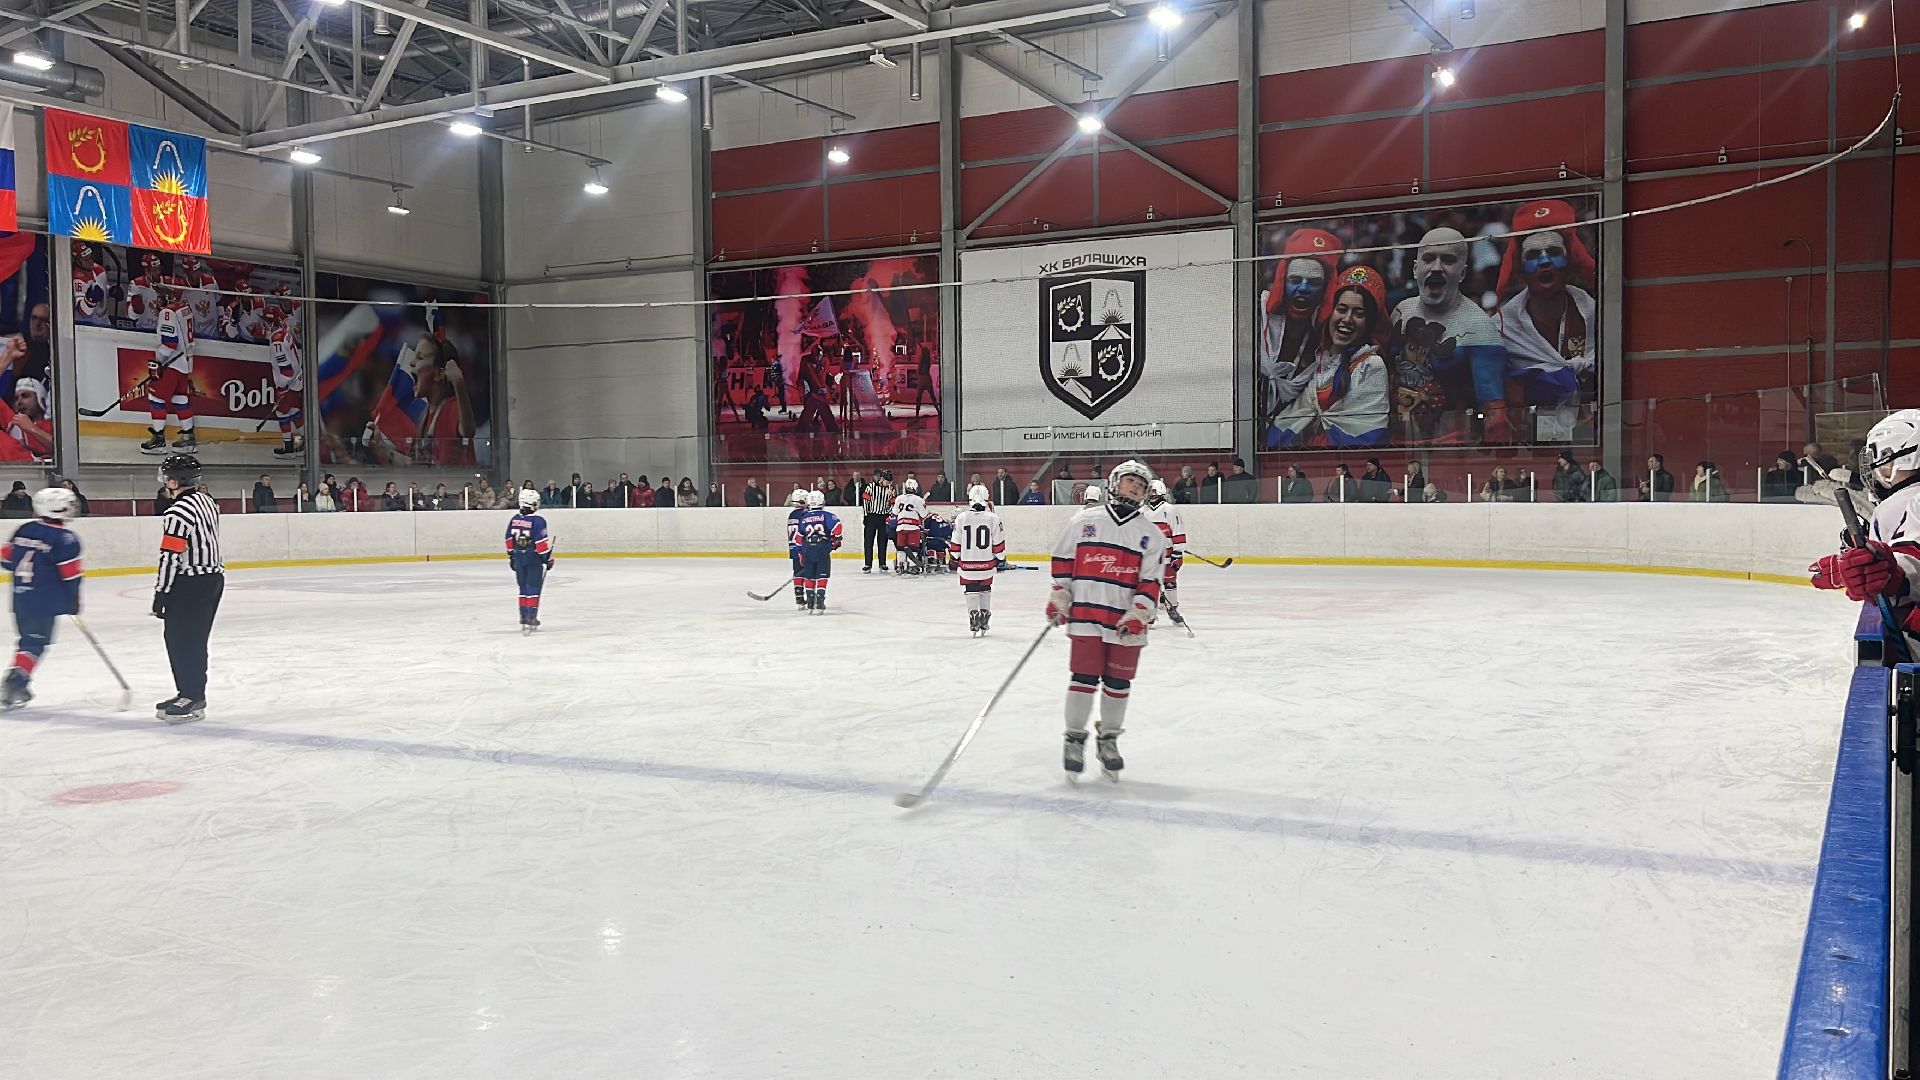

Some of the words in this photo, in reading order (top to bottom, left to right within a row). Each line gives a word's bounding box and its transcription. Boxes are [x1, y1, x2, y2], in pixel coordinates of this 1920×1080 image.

[1039, 261, 1059, 275] ХК
[1062, 253, 1147, 269] БАЛАШИХА
[221, 379, 275, 412] Boh
[1053, 431, 1090, 440] ИМЕНИ
[963, 524, 991, 550] 10
[14, 550, 35, 584] 4
